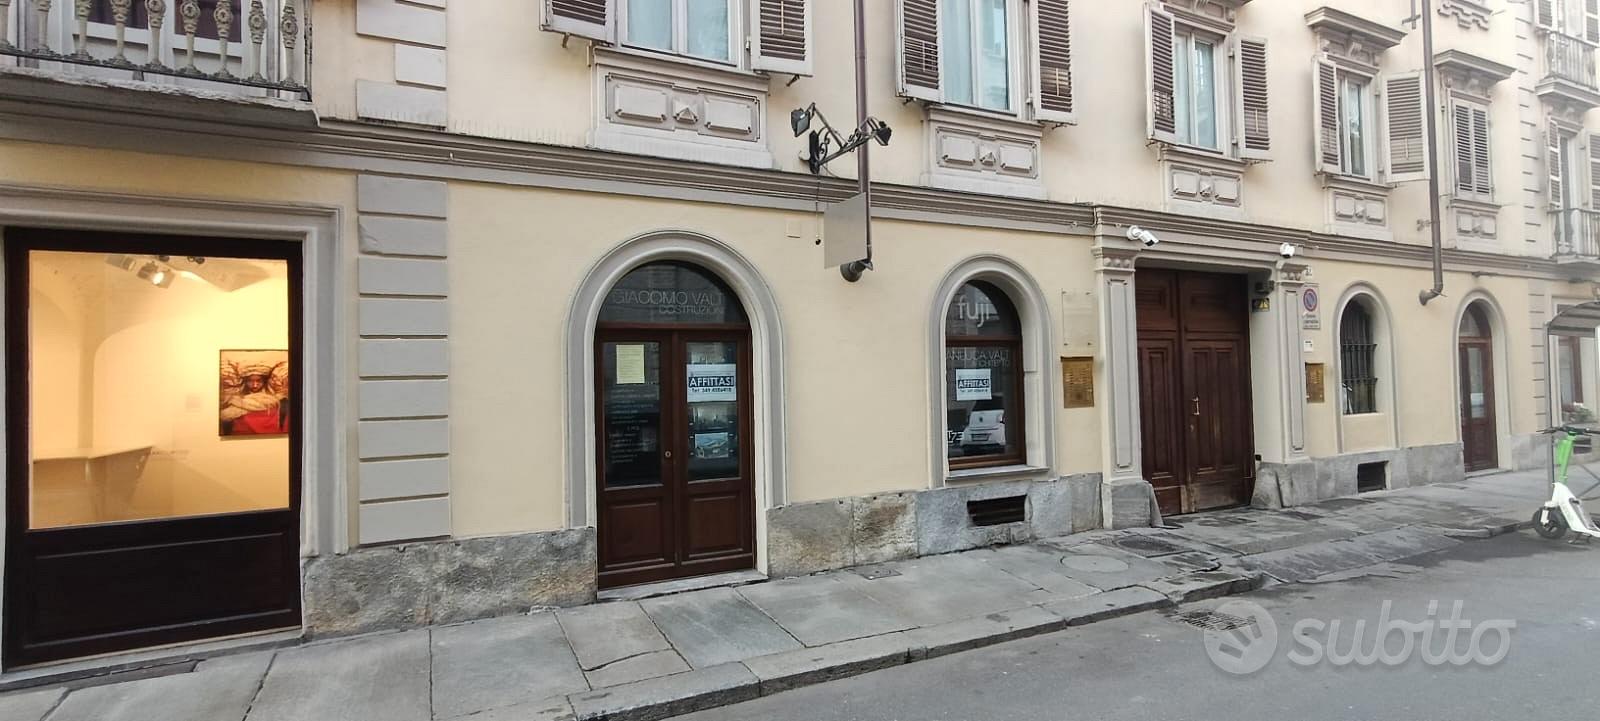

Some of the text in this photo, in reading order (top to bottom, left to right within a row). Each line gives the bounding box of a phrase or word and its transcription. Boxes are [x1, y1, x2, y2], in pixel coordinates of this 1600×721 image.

[613, 290, 688, 305] GIACOMO
[957, 294, 990, 328] fuji
[689, 376, 734, 387] AFFITTASI
